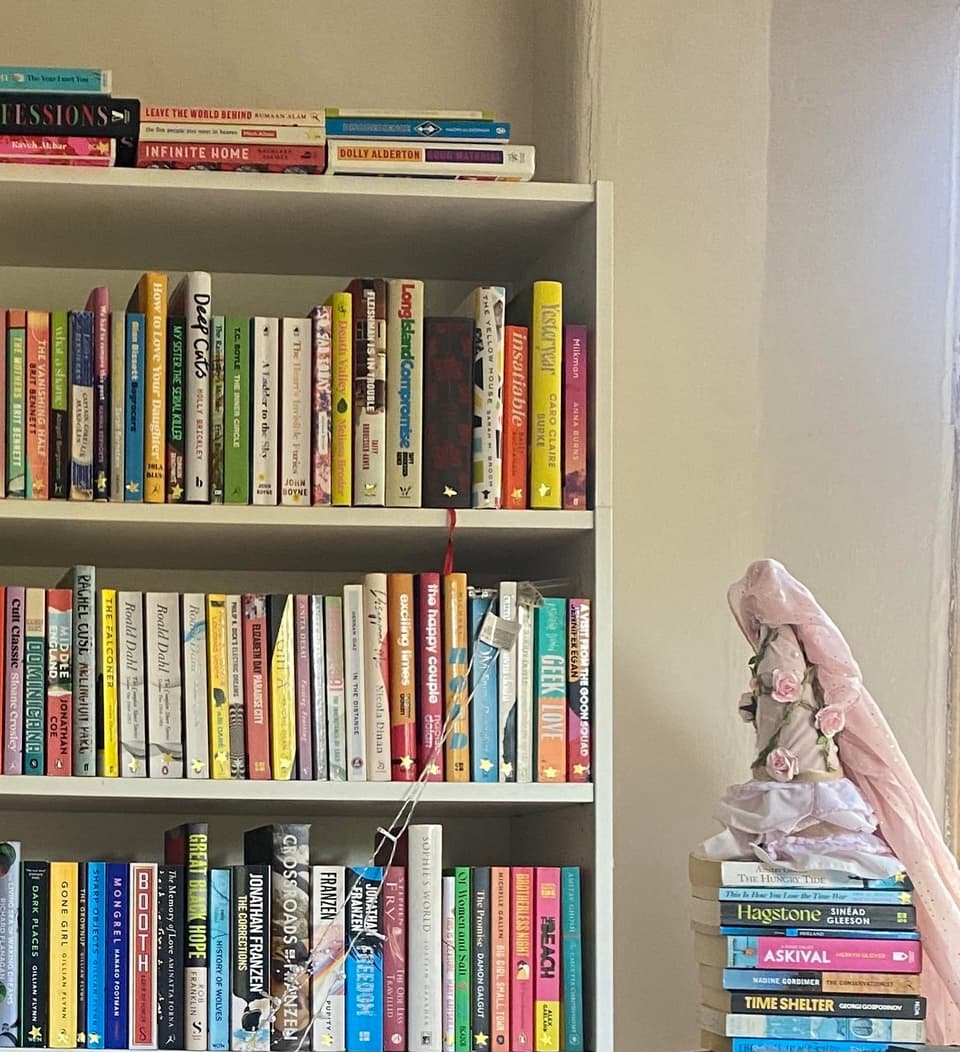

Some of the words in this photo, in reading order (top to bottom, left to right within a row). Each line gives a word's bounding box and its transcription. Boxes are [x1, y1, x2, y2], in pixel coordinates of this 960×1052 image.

[145, 108, 168, 118] LEAVE
[170, 109, 187, 118] THE
[190, 110, 219, 119] WORLD
[221, 110, 252, 119] BEHIND
[145, 146, 206, 160] INFINITE
[212, 147, 249, 160] HOME
[340, 148, 368, 159] DOLLY
[371, 149, 420, 159] ALDERTON
[193, 338, 207, 378] Cuts
[512, 331, 527, 427] insatiable
[428, 584, 439, 606] the
[426, 606, 439, 652] happy
[426, 655, 438, 704] couple
[49, 716, 57, 738] COE
[59, 698, 67, 755] JONATHAN
[61, 881, 69, 913] GONE
[238, 896, 246, 912] THE
[250, 873, 263, 932] JONATHAN
[138, 873, 148, 971] BOOTH
[737, 905, 821, 923] Hagstone
[827, 916, 870, 925] GLEESON
[238, 914, 247, 971] CORRECTIONS
[764, 949, 831, 963] ASKIVAL
[250, 934, 263, 993] FRANZEN
[744, 997, 777, 1010] TIME
[780, 998, 834, 1012] SHELTER
